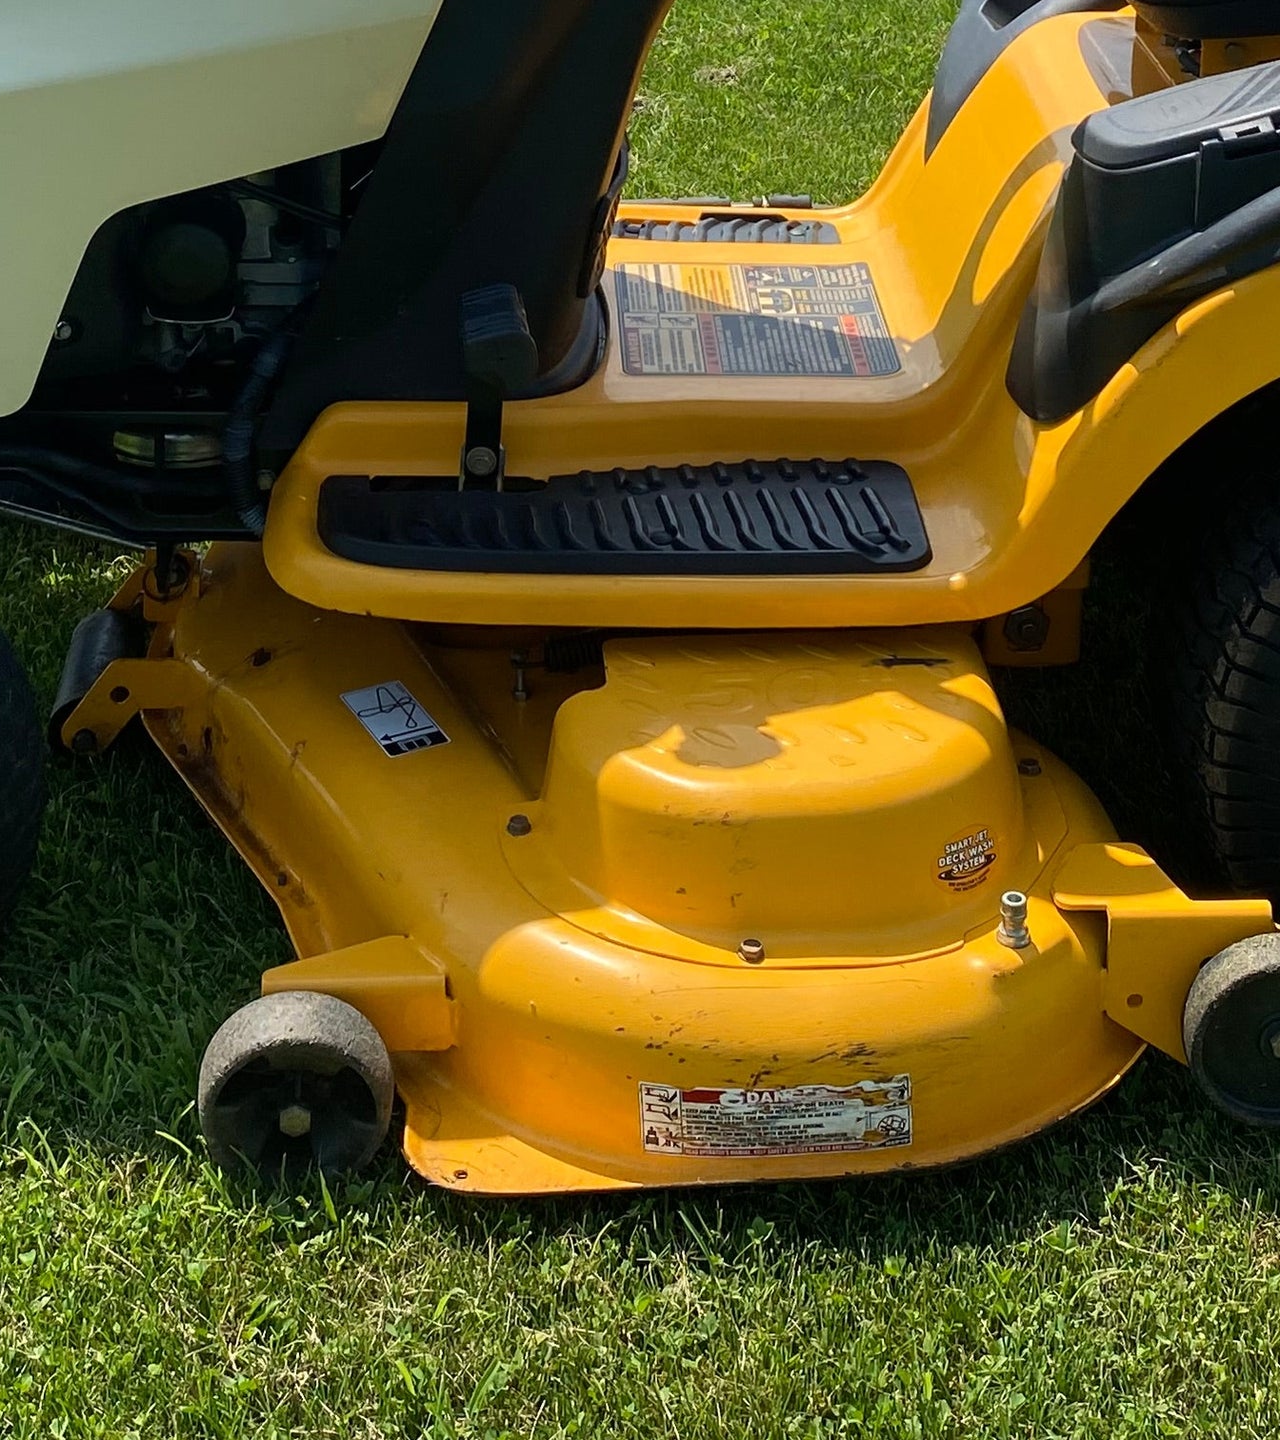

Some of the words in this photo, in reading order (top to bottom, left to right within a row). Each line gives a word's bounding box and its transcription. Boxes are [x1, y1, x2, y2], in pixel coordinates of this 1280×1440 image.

[938, 851, 966, 867] DECK
[968, 839, 994, 857] WASH
[944, 836, 973, 854] SMART
[974, 829, 988, 843] JET
[952, 855, 986, 874] SYSTEM
